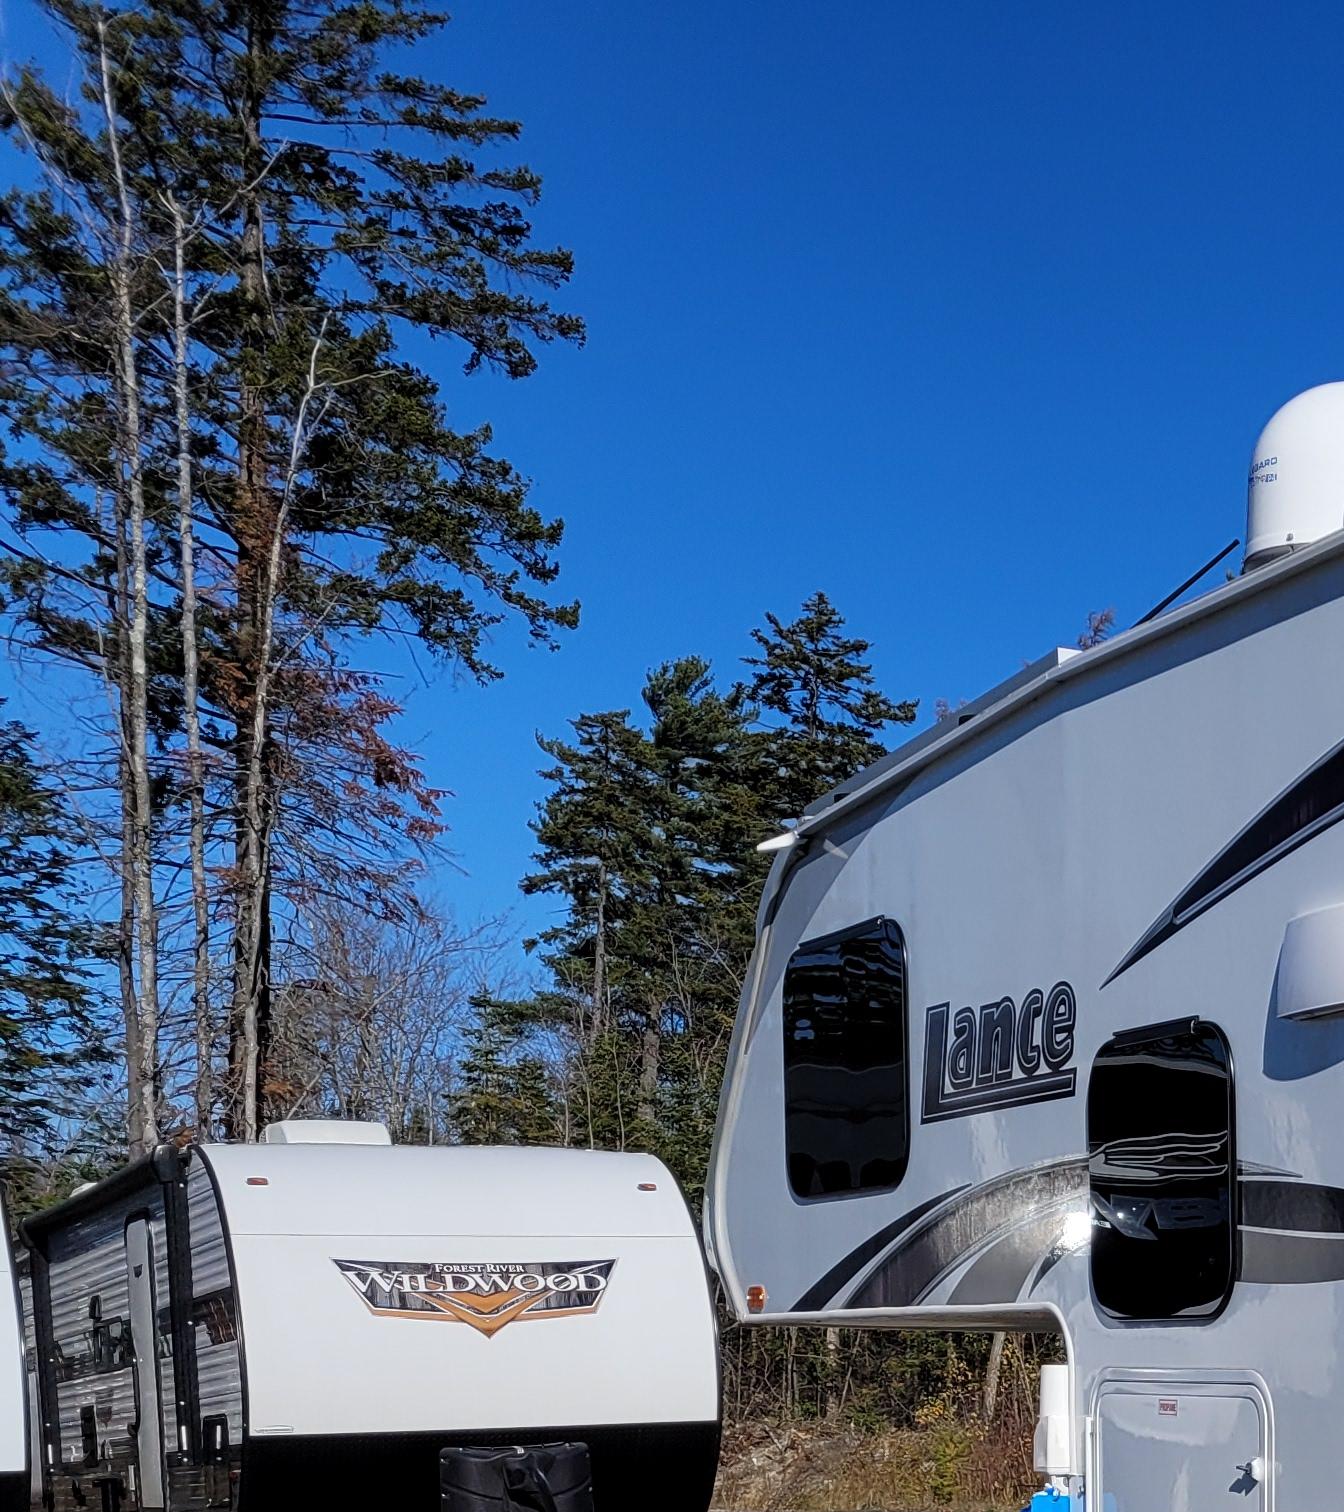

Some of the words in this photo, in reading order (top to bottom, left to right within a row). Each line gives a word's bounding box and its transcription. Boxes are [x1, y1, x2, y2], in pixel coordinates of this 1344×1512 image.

[920, 981, 1077, 1125] Lance
[434, 1263, 485, 1273] FOREST
[486, 1263, 525, 1273] RIVER
[341, 1270, 608, 1293] WILDWOOD
